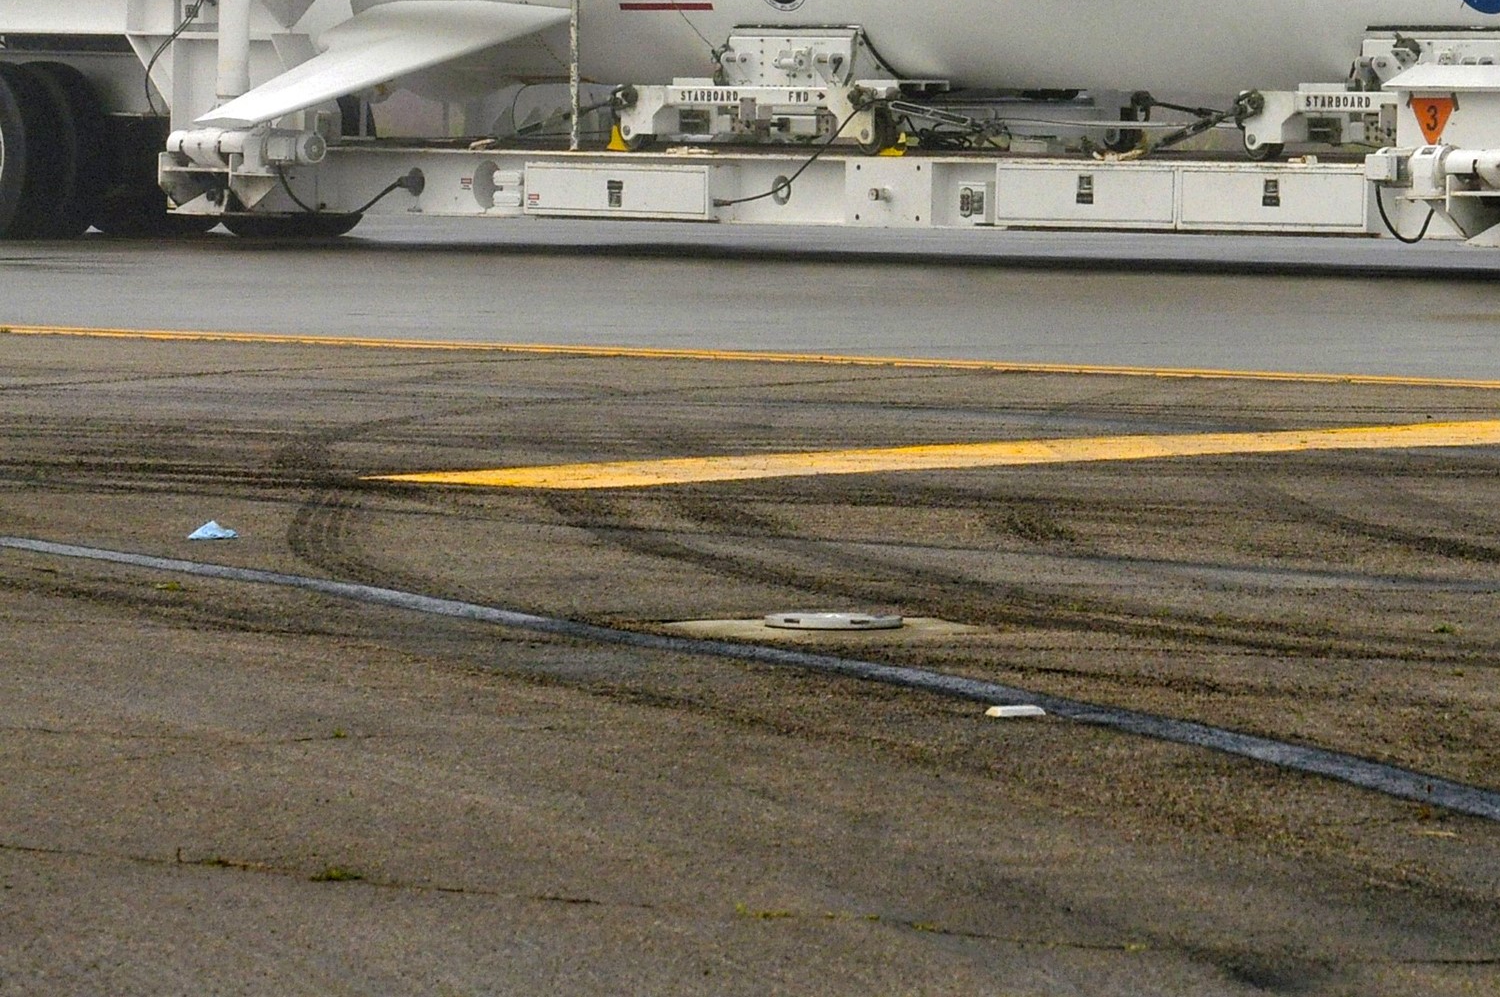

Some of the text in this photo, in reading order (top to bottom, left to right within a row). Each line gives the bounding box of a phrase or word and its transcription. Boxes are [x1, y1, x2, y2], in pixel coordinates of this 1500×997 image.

[681, 91, 809, 102] STARBOARD FWD
[1305, 96, 1371, 108] STARBOARD
[1426, 105, 1438, 132] 3
